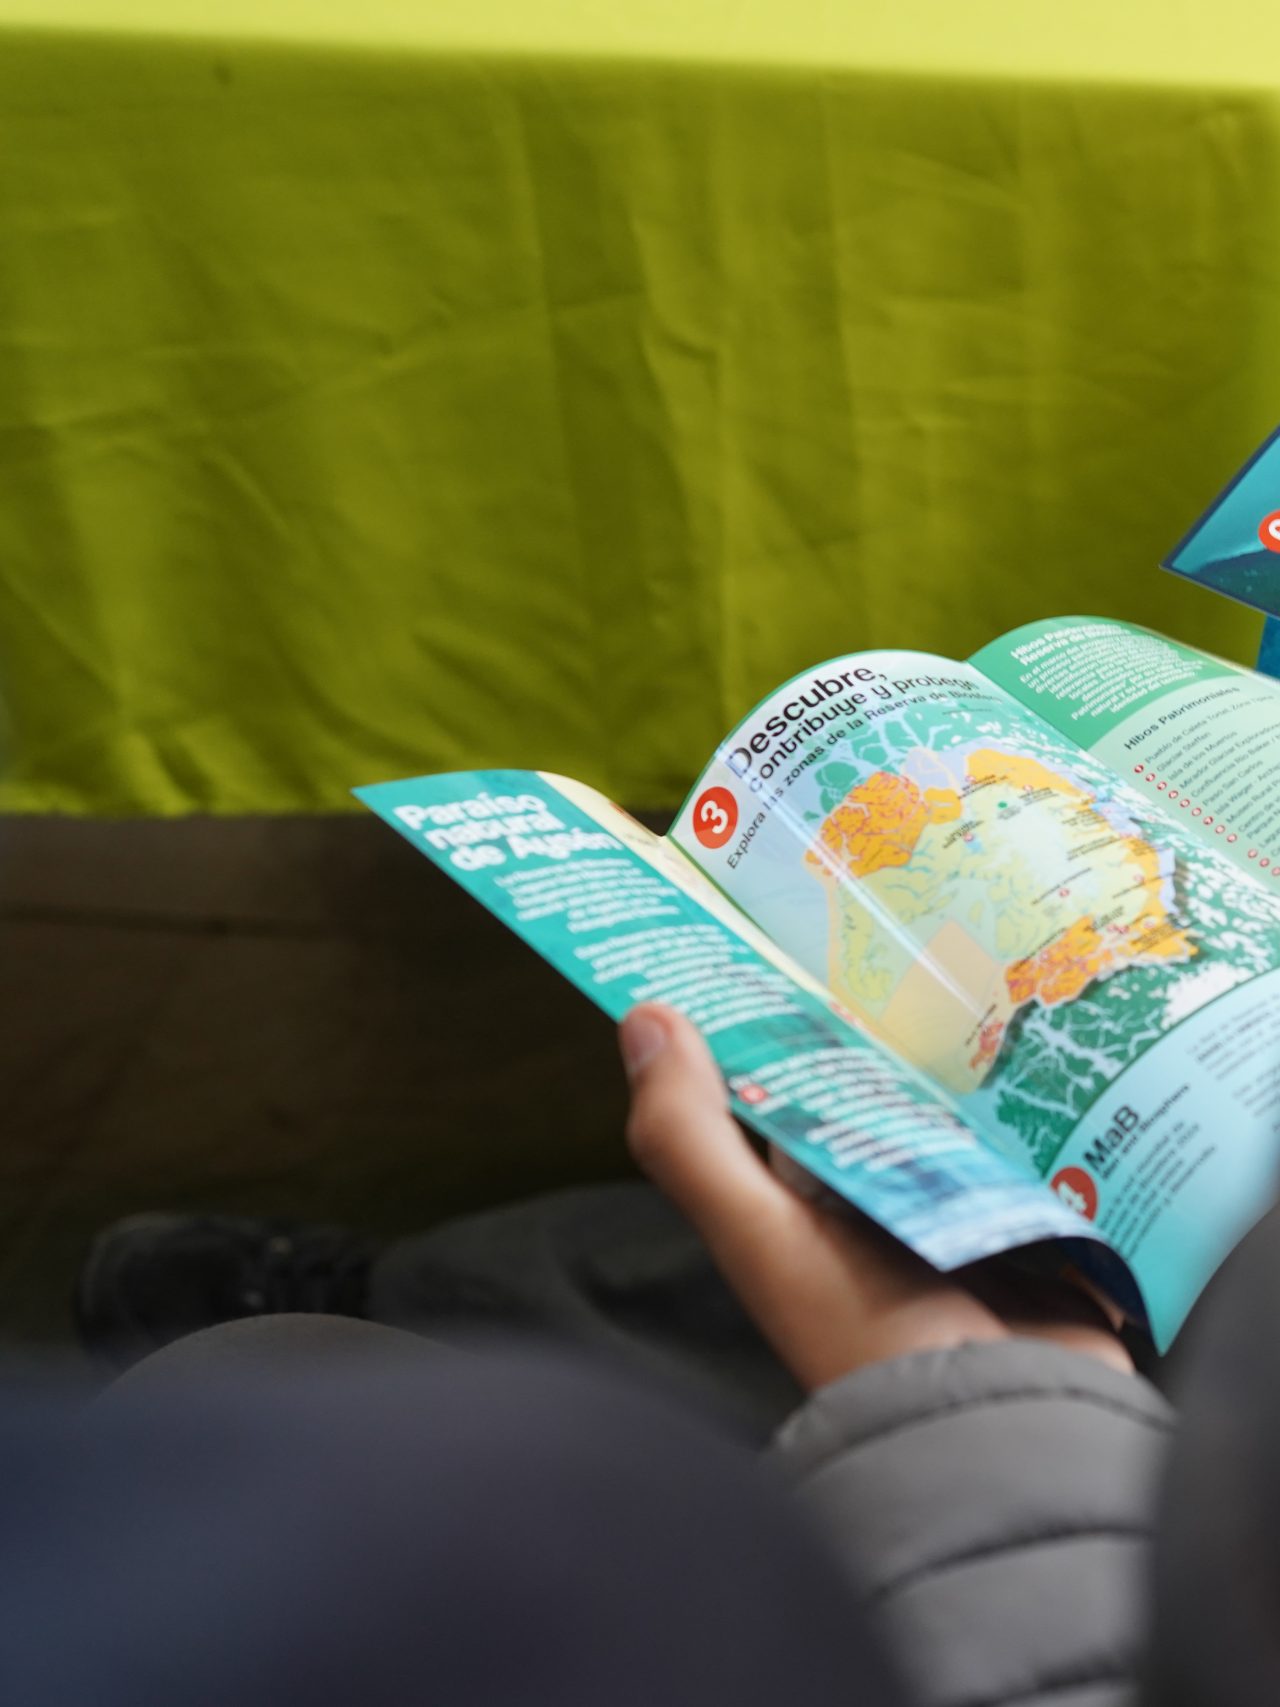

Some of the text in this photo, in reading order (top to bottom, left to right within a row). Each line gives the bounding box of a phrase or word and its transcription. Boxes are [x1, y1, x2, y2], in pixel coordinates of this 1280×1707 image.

[724, 667, 888, 778] Descubre,
[750, 692, 868, 795] contribuye
[872, 683, 892, 701] y
[727, 810, 766, 869] Explora
[784, 744, 825, 786] zonas
[826, 728, 846, 746] de
[847, 717, 864, 731] la
[864, 695, 926, 721] Reserva
[392, 792, 548, 830] Paraíso
[423, 810, 566, 850] natural
[701, 800, 729, 834] 3
[450, 827, 625, 871] de Aysén
[1083, 1105, 1140, 1173] MaB
